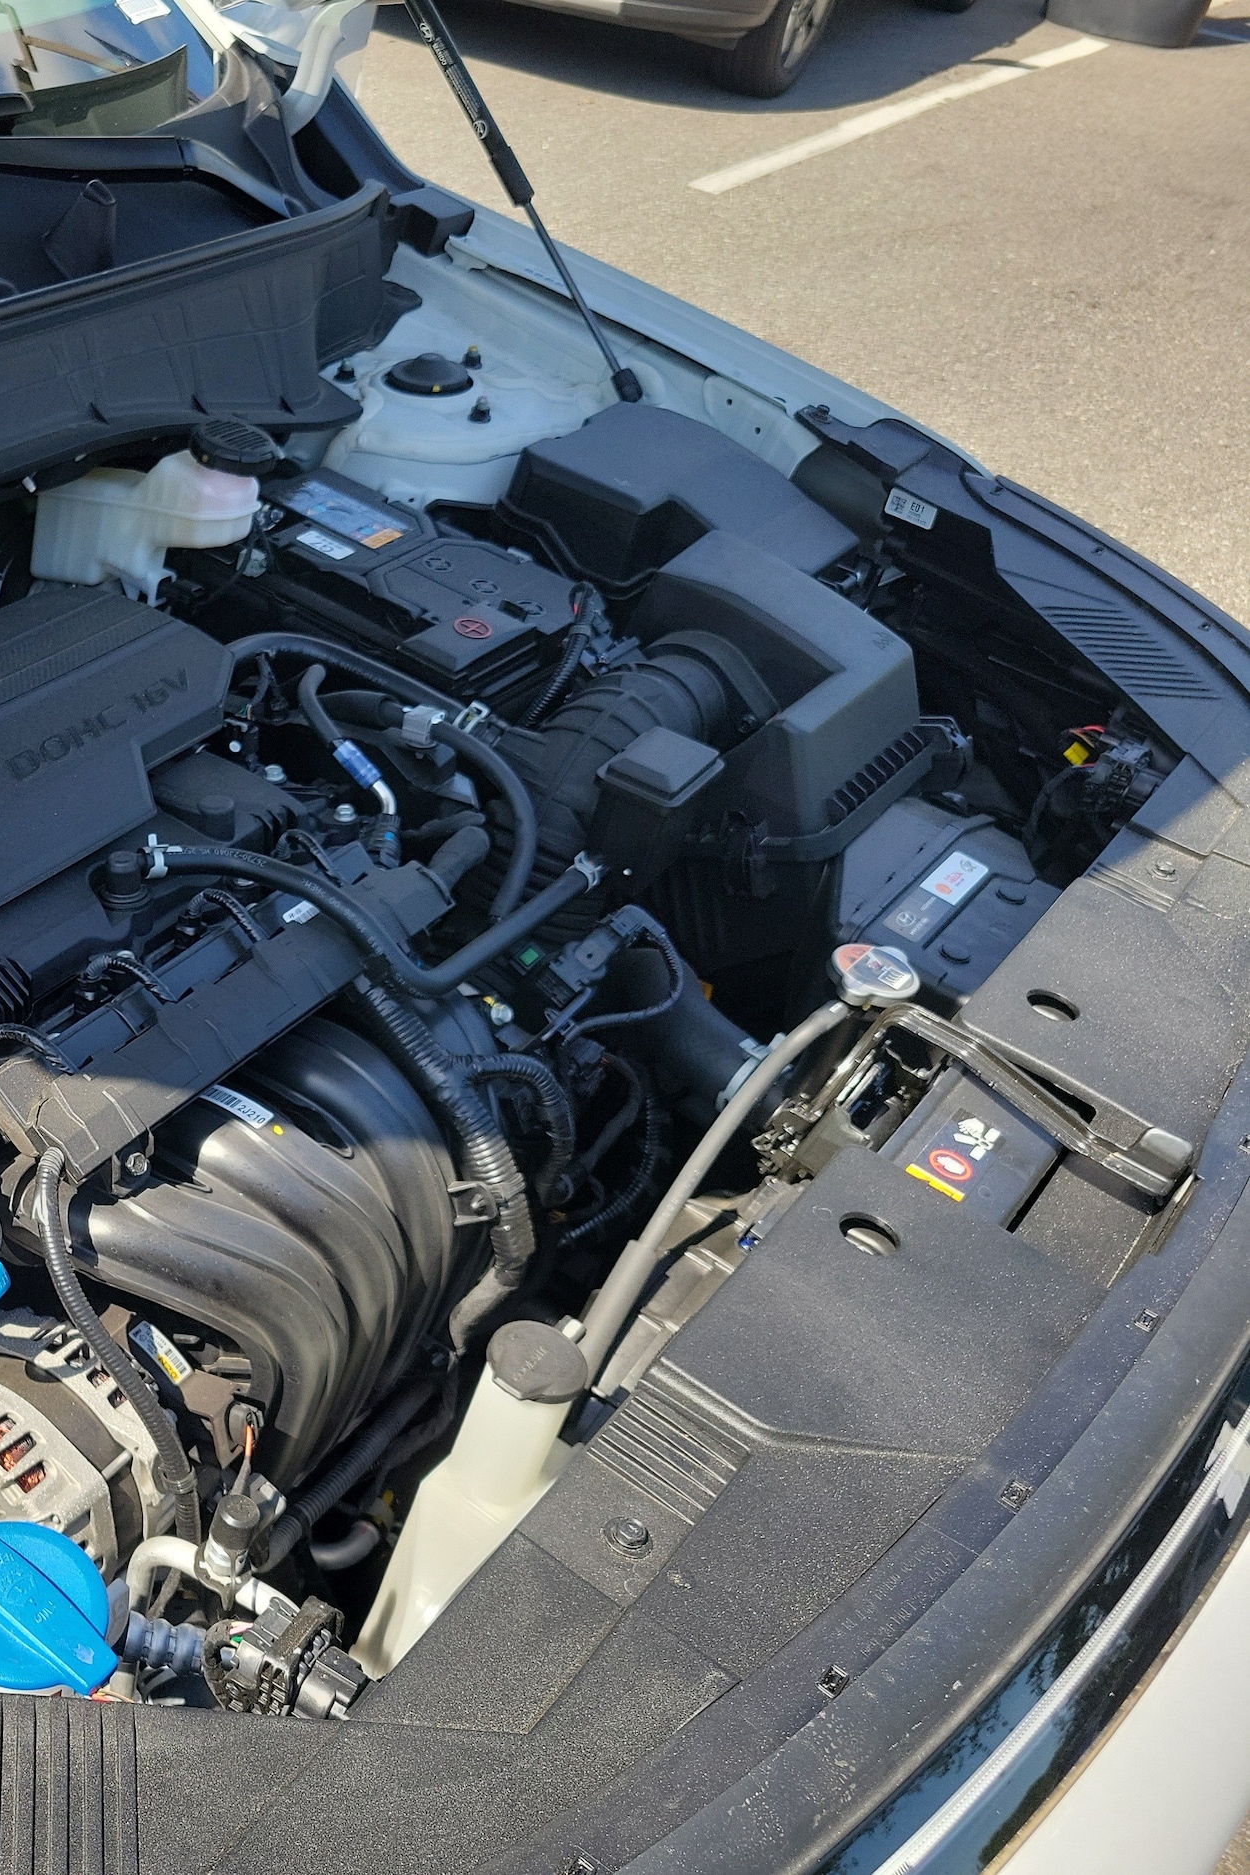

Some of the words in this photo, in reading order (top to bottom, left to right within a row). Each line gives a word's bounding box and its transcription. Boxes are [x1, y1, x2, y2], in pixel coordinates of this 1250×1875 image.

[910, 501, 925, 514] E01
[3, 702, 128, 782] DOHC
[126, 667, 190, 715] 16V
[238, 1104, 266, 1125] 2J210
